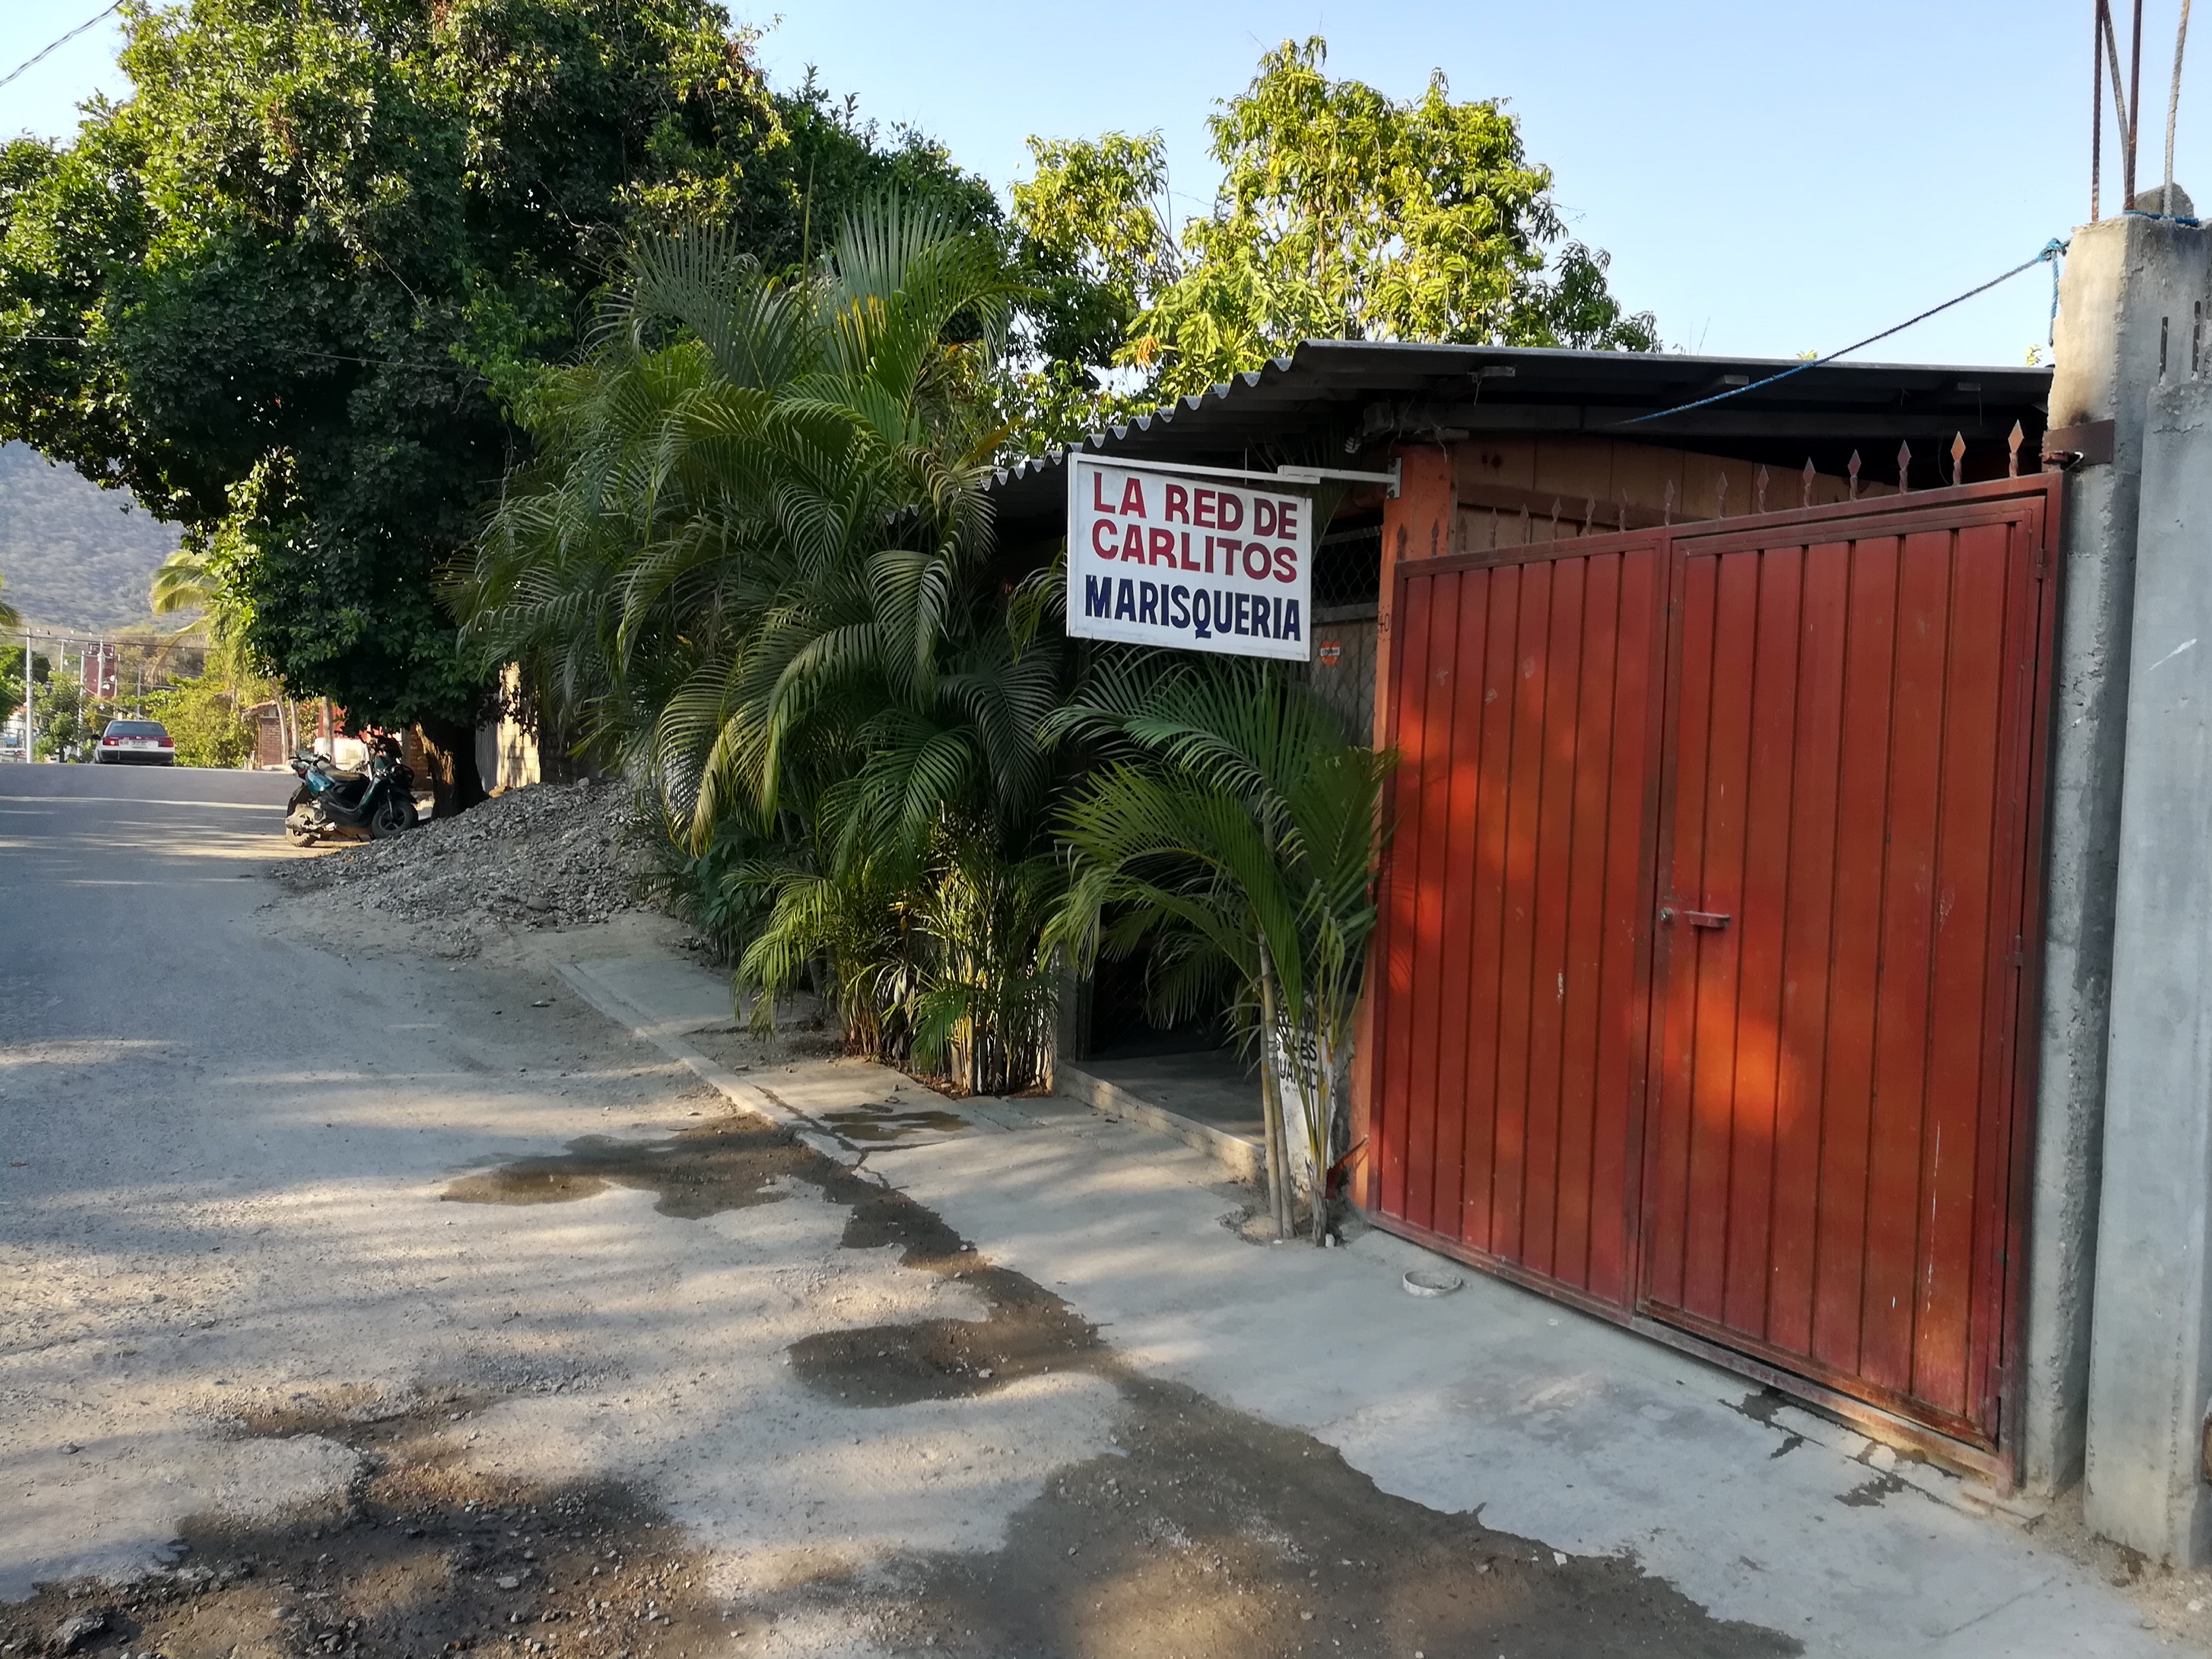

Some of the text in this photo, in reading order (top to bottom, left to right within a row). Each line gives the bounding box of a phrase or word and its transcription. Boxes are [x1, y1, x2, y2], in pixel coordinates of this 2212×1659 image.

[1093, 472, 1297, 540] LA RED DE
[1092, 518, 1297, 583] CARLITOS
[1085, 574, 1301, 642] MARISQUERIA
